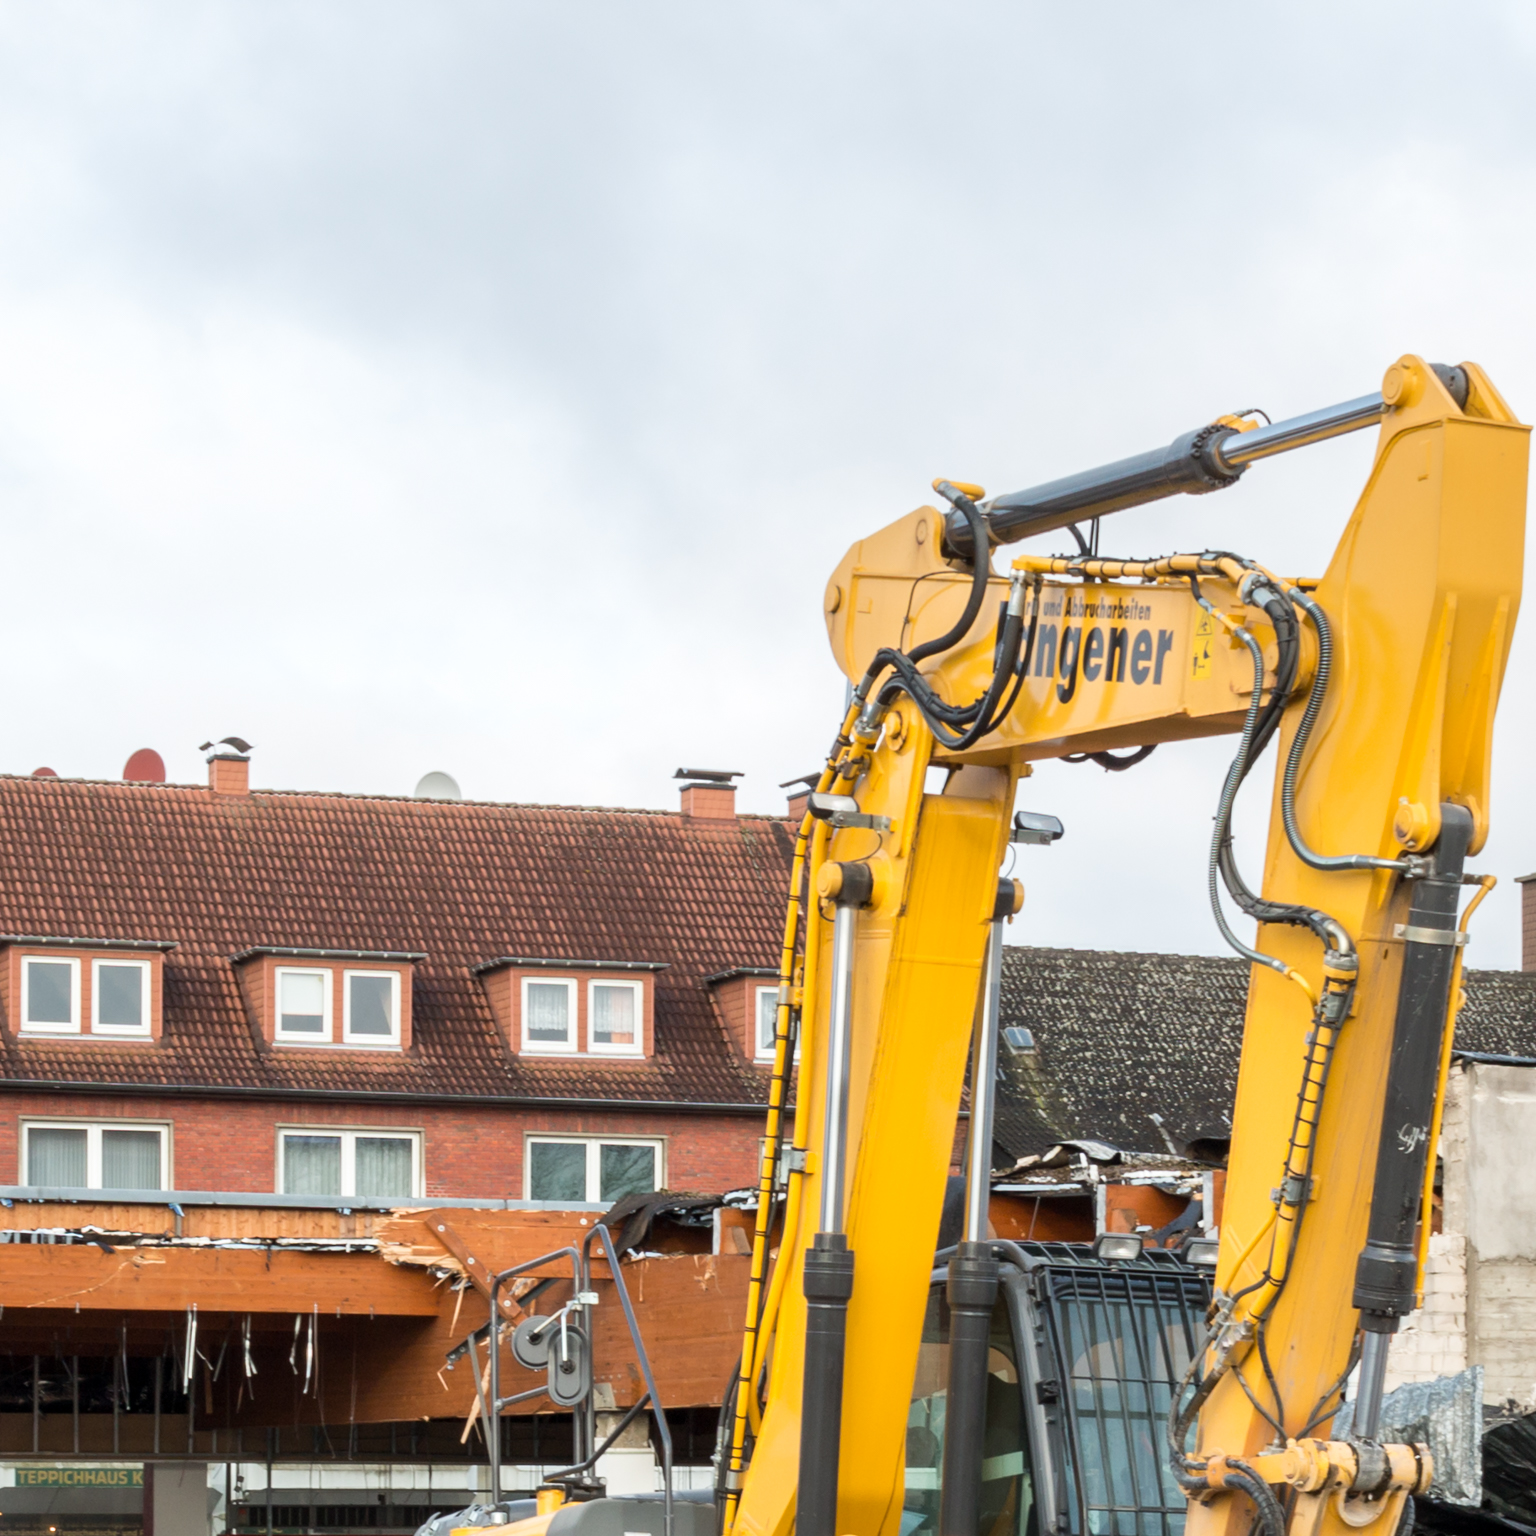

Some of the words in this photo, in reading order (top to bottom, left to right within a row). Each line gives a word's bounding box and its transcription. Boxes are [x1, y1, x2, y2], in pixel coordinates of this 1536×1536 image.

[1043, 594, 1063, 617] und
[1064, 595, 1151, 620] Abbrucharbeiten
[17, 1470, 128, 1485] TEPPICHHAUS
